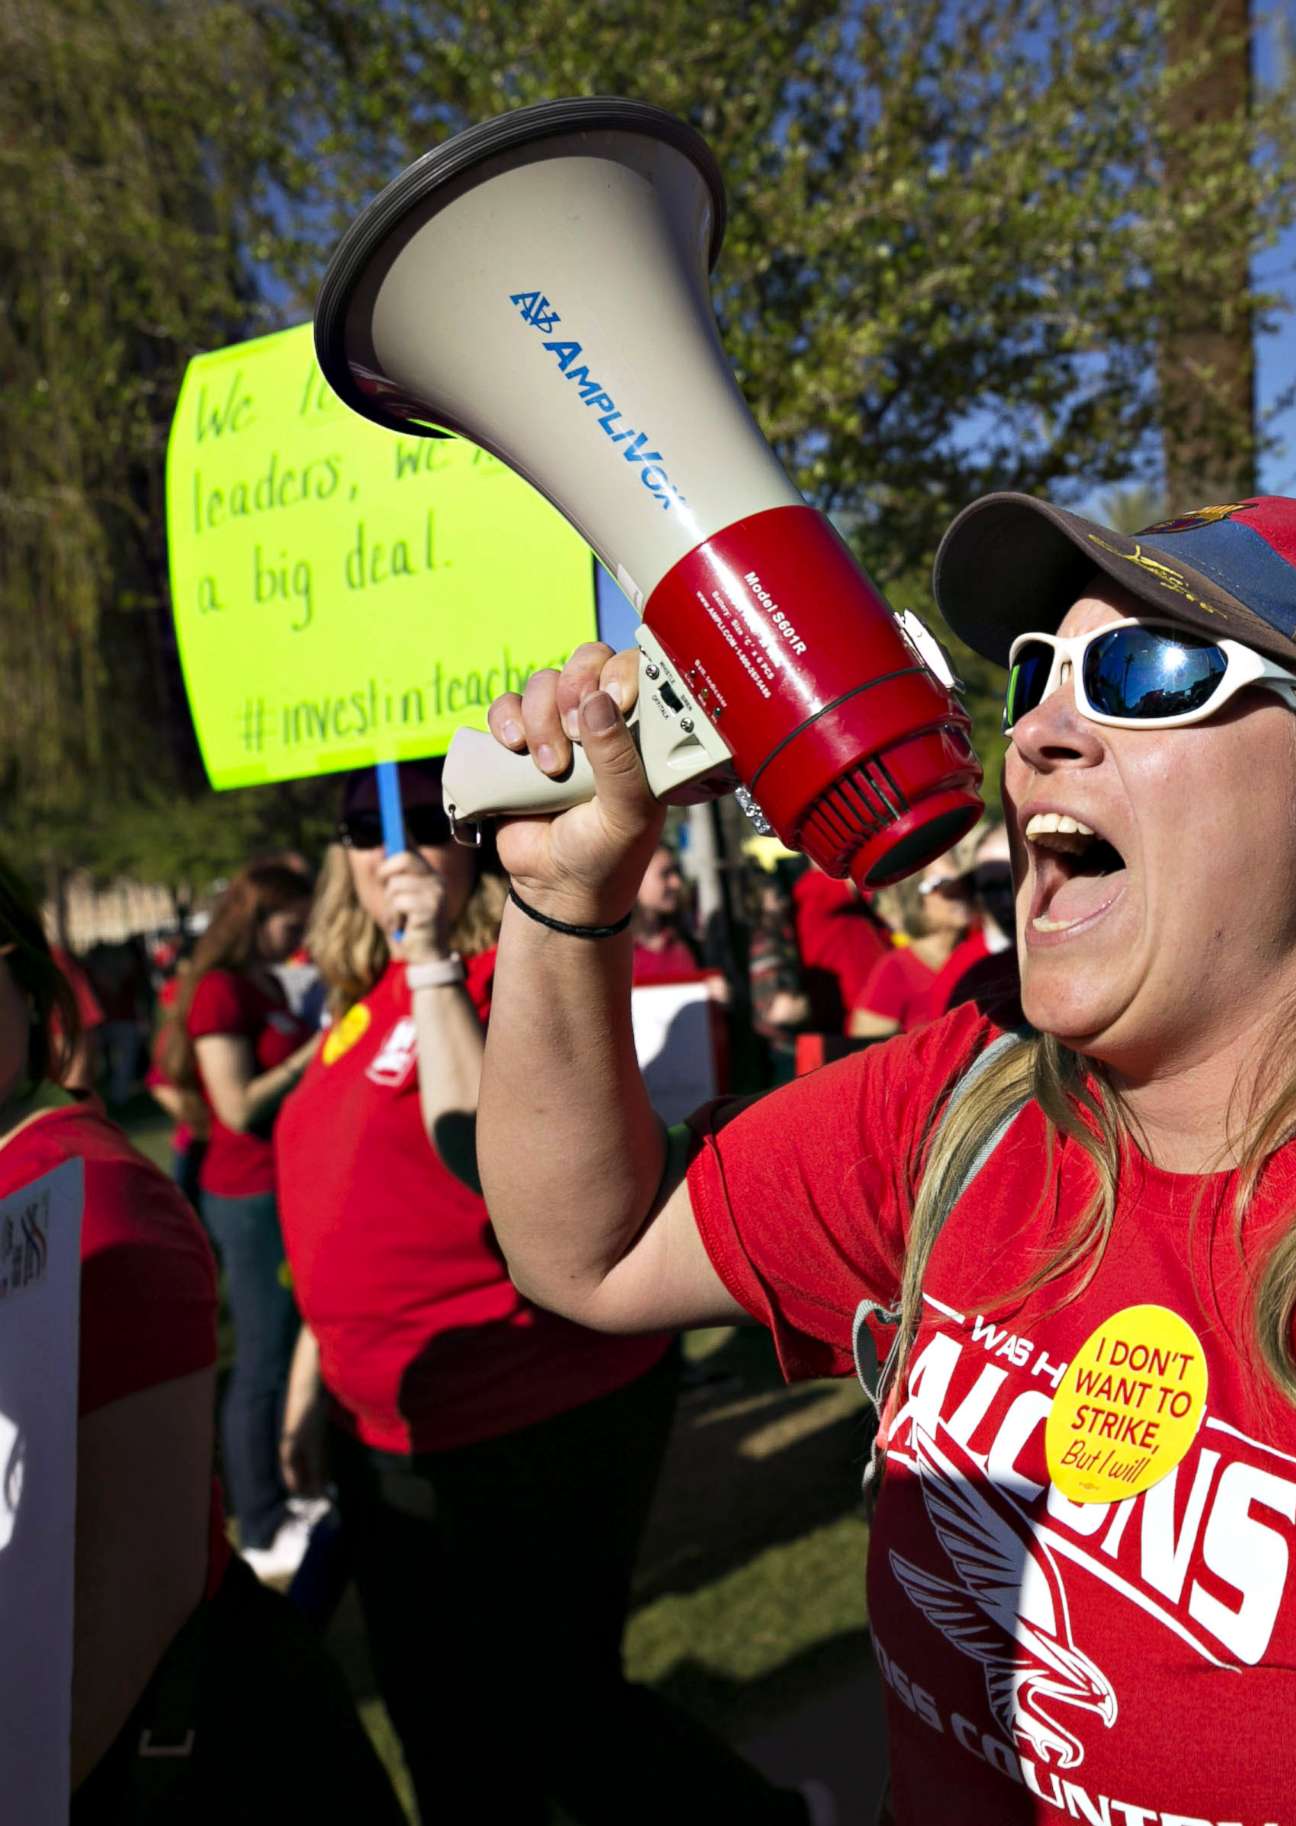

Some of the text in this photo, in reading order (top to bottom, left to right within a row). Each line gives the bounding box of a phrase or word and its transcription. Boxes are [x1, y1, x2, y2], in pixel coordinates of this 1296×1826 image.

[197, 371, 255, 444] We
[193, 450, 358, 534] leaders,
[198, 509, 454, 632] a big deal.
[744, 571, 808, 656] Model S601R
[1074, 1367, 1193, 1419] WANT TO
[1096, 1336, 1194, 1381] I DON'T
[1060, 1438, 1151, 1484] But I will
[1071, 1404, 1160, 1455] STRIKE,
[871, 1632, 944, 1735] OSS
